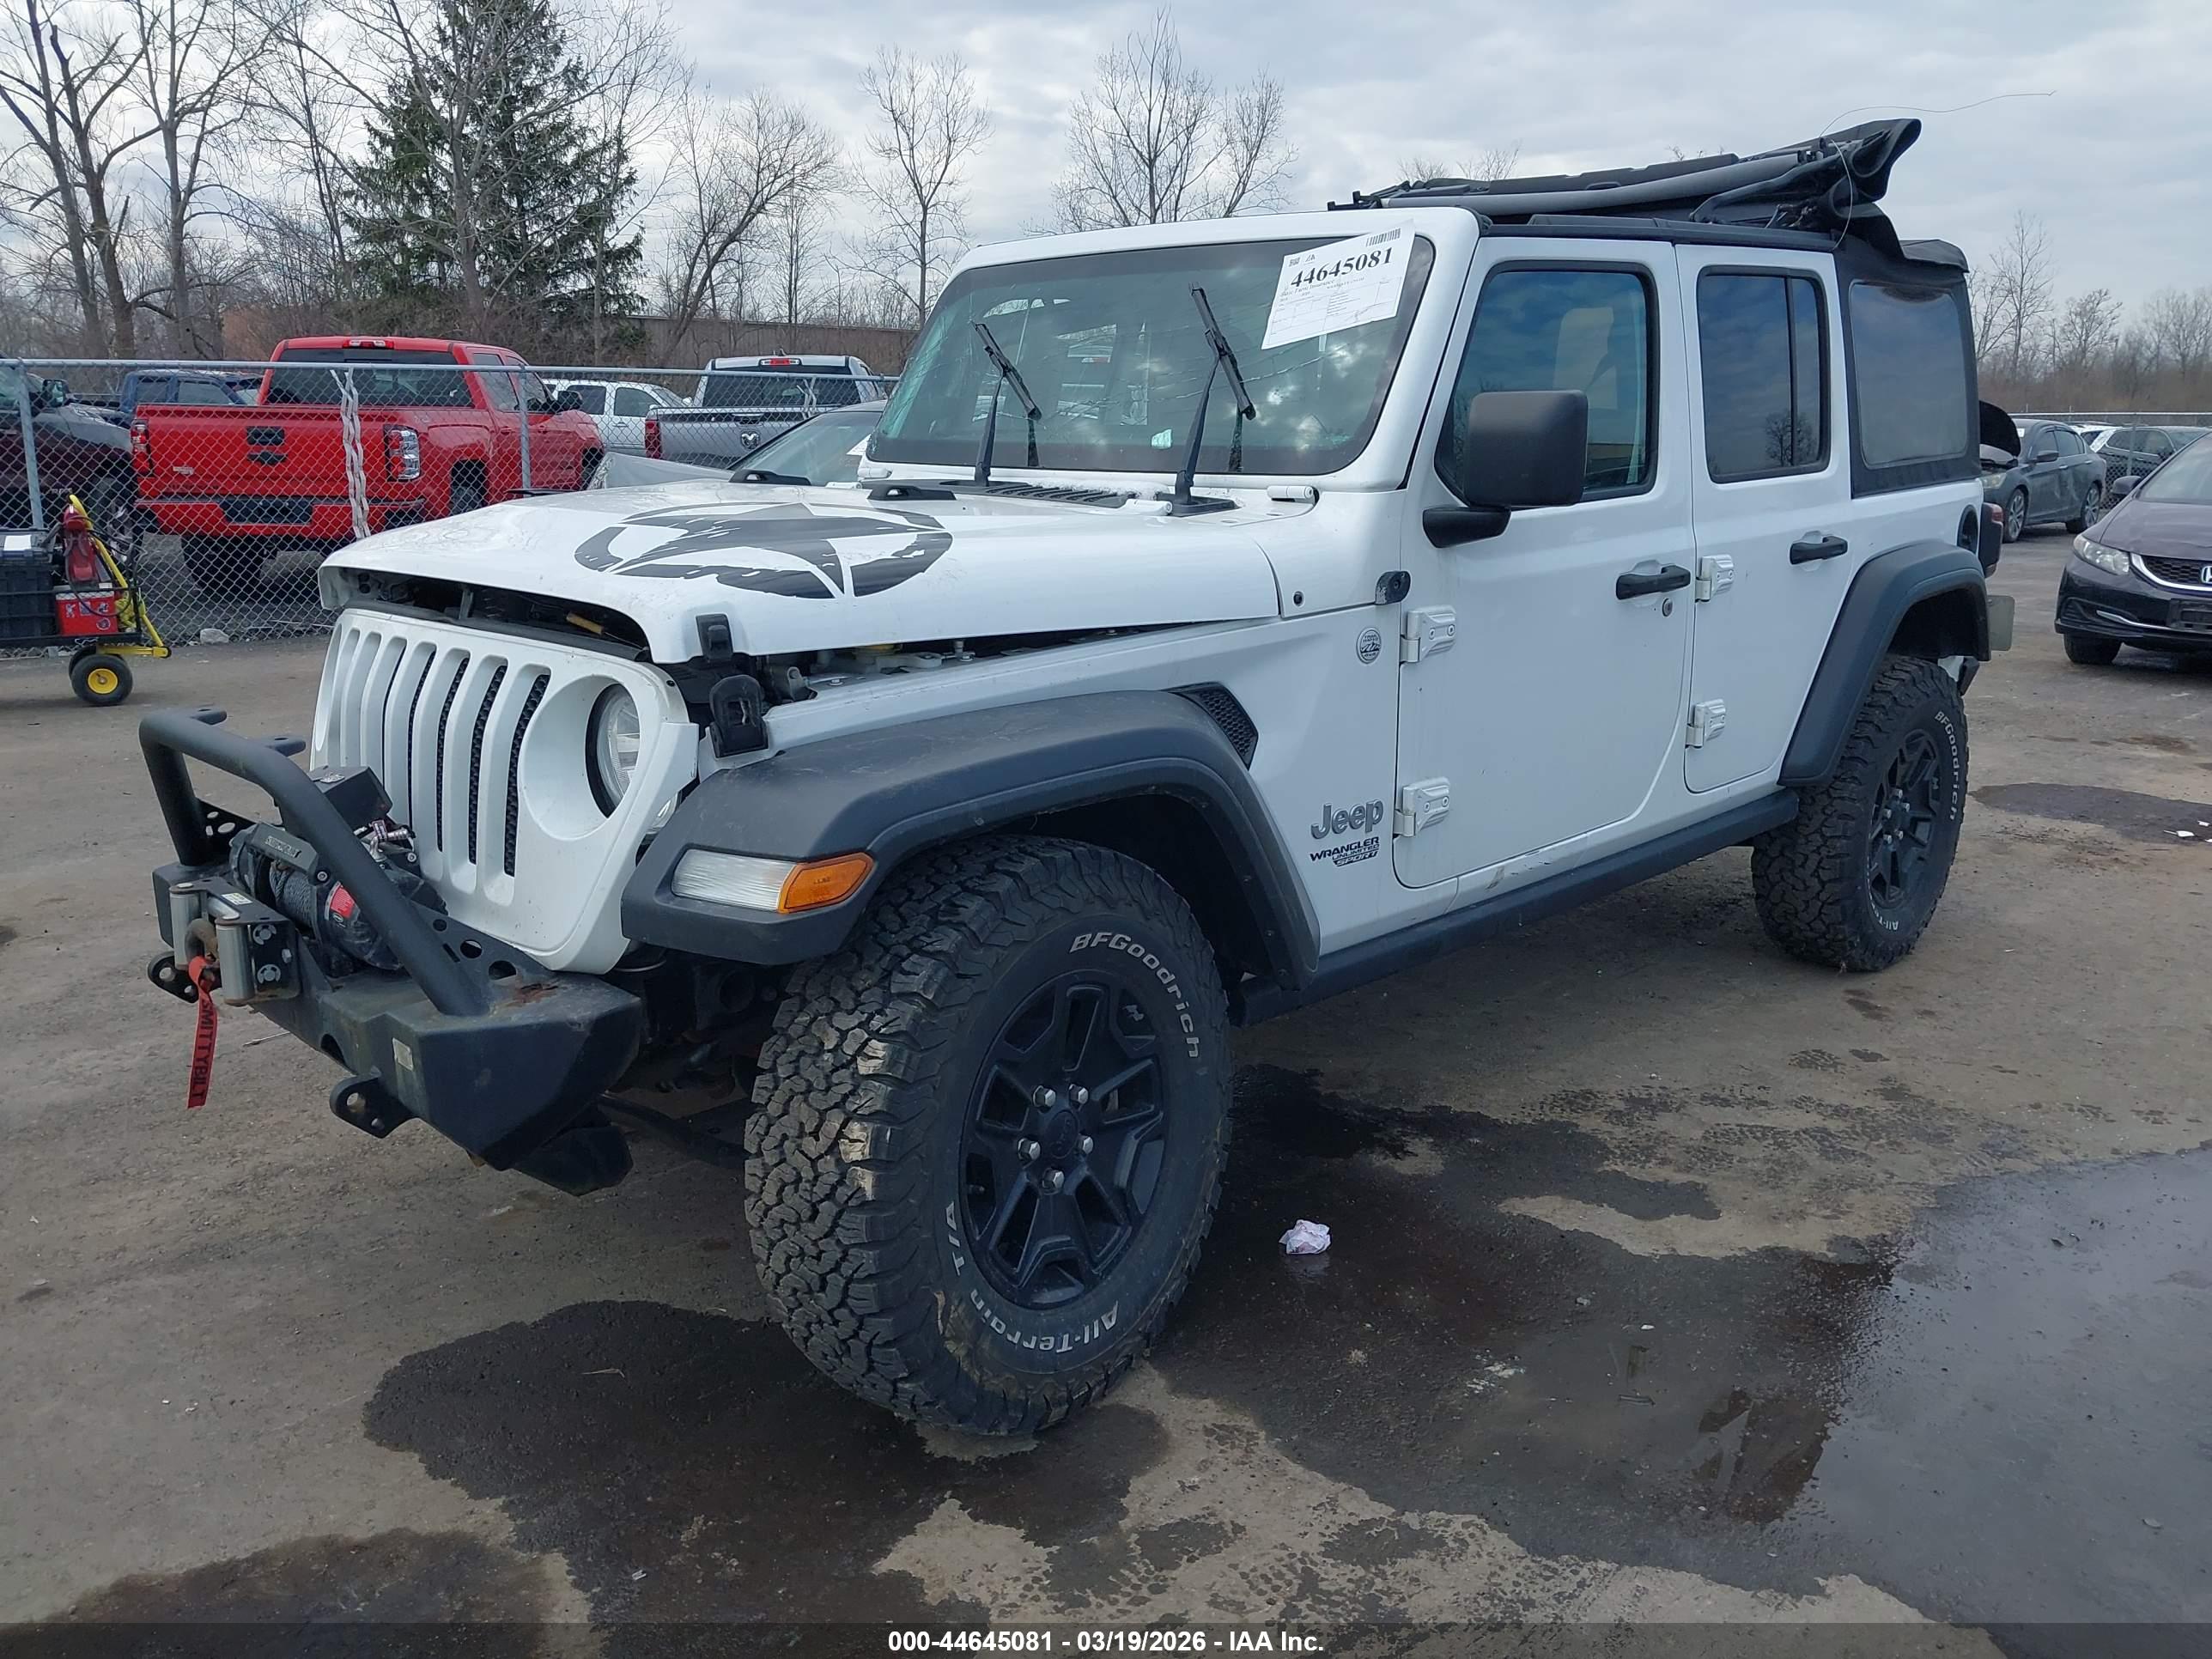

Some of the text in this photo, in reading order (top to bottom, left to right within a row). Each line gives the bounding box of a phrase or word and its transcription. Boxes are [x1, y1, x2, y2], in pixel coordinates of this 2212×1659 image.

[1290, 246, 1393, 288] 44645081
[1934, 710, 1960, 821] BFGoodrich
[1310, 799, 1384, 840] Jeep
[1310, 836, 1380, 861] WRANGLER
[1332, 843, 1380, 860] UNLIMITED
[1069, 932, 1200, 1058] BFGoodrich
[191, 998, 214, 1100] SMITTYBILT
[945, 1200, 1119, 1353] All-Terrain T/A
